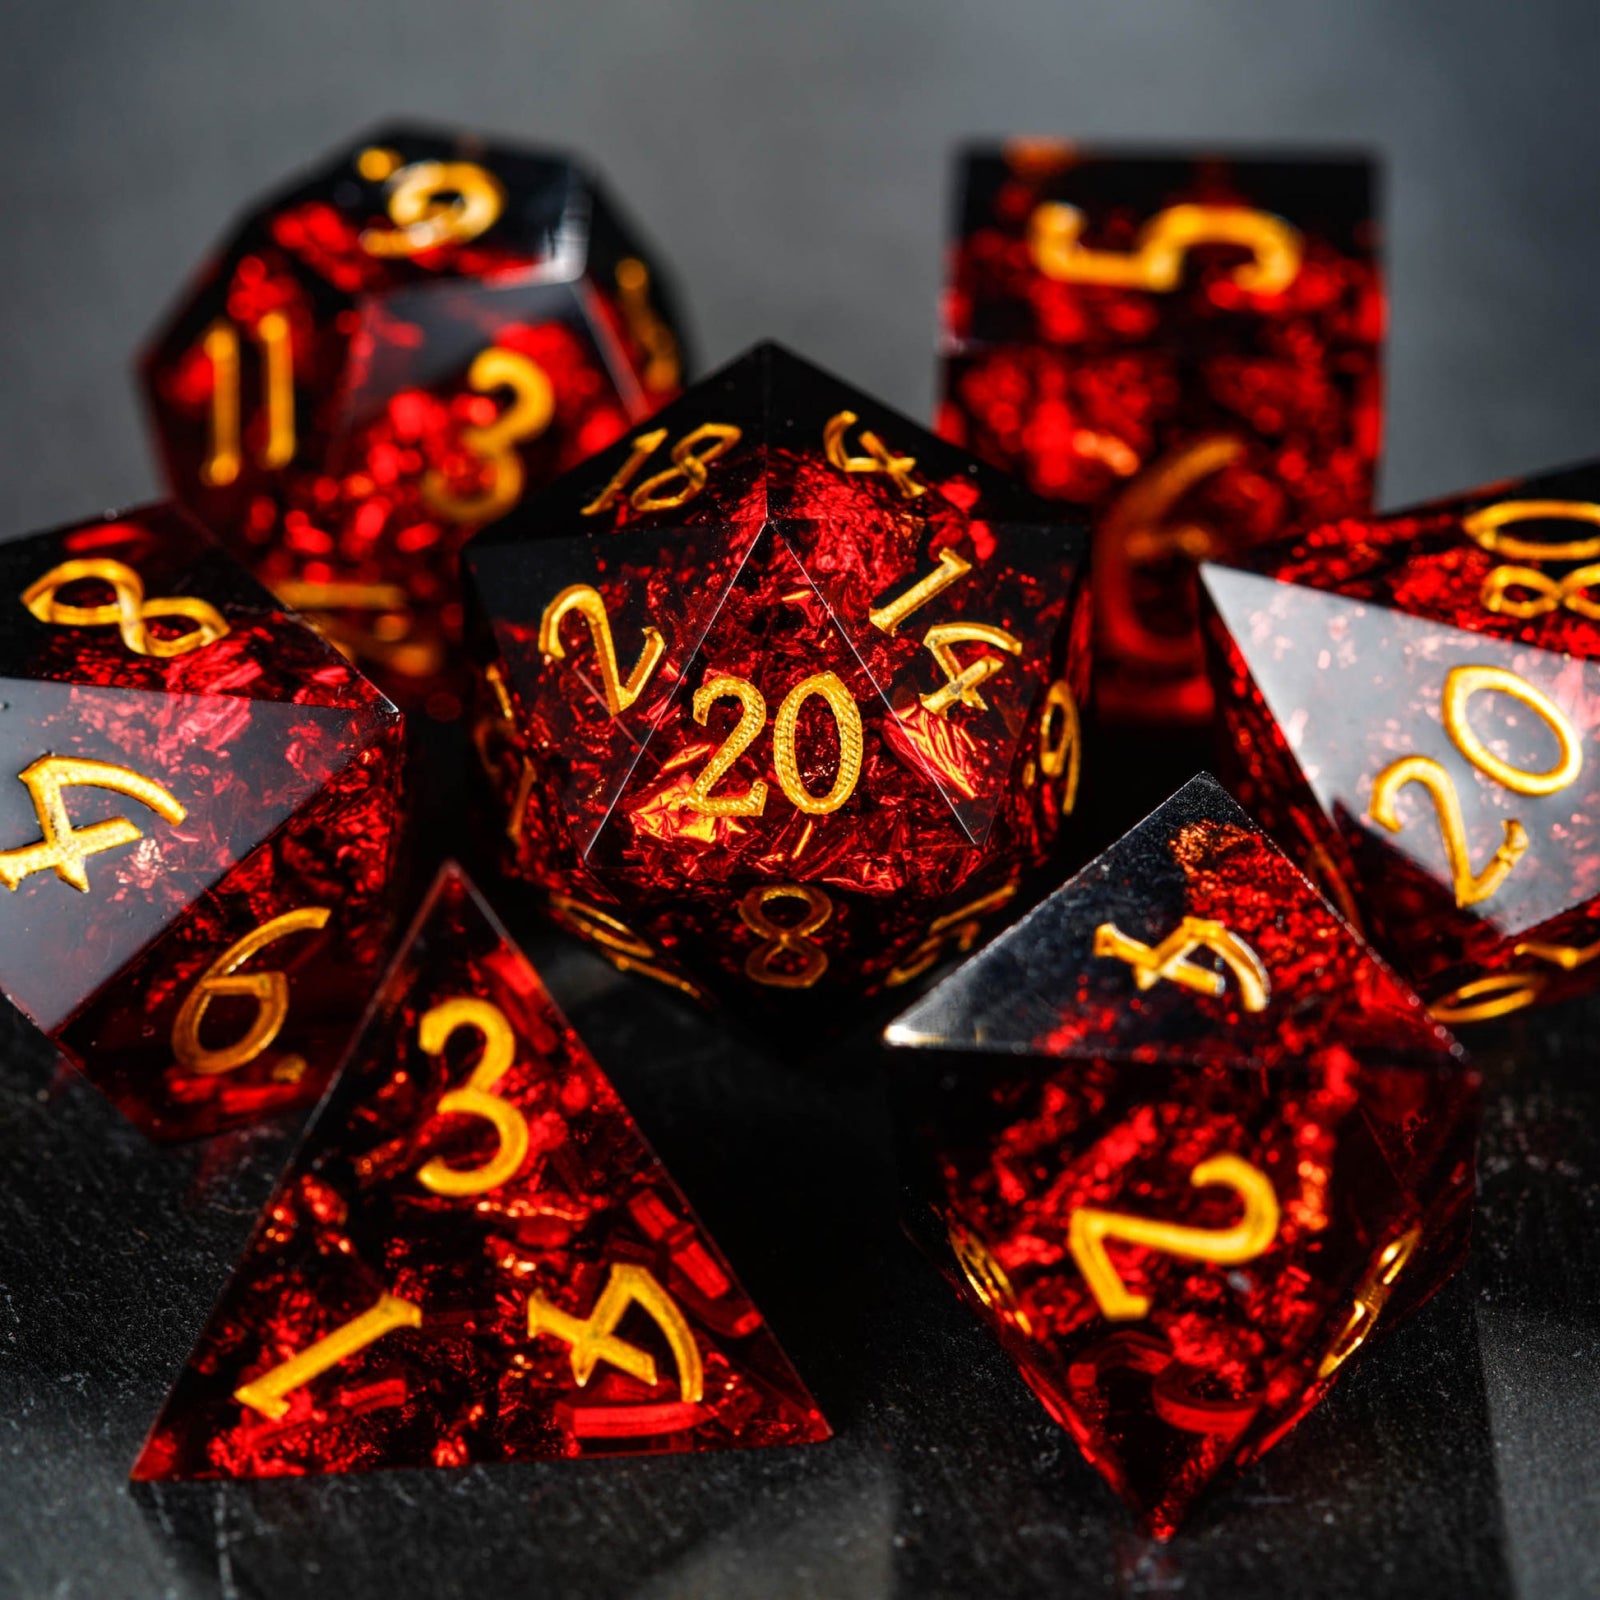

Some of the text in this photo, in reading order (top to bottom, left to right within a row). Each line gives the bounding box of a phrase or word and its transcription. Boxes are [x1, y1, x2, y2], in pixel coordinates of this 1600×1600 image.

[1030, 202, 1300, 293] 5
[202, 312, 296, 487] 11
[424, 347, 555, 519] 3
[824, 411, 927, 498] 4
[580, 423, 742, 516] 18
[21, 558, 230, 658] 8
[538, 584, 665, 715] 2
[870, 548, 1023, 716] 14
[682, 671, 864, 818] 20
[1369, 664, 1583, 908] 20
[0, 753, 188, 893] 4
[738, 886, 834, 988] 8
[1094, 916, 1270, 1012] 4
[417, 998, 530, 1197] 3
[1068, 1152, 1280, 1321] 2
[234, 1293, 422, 1420] 1
[527, 1263, 703, 1402] 4
